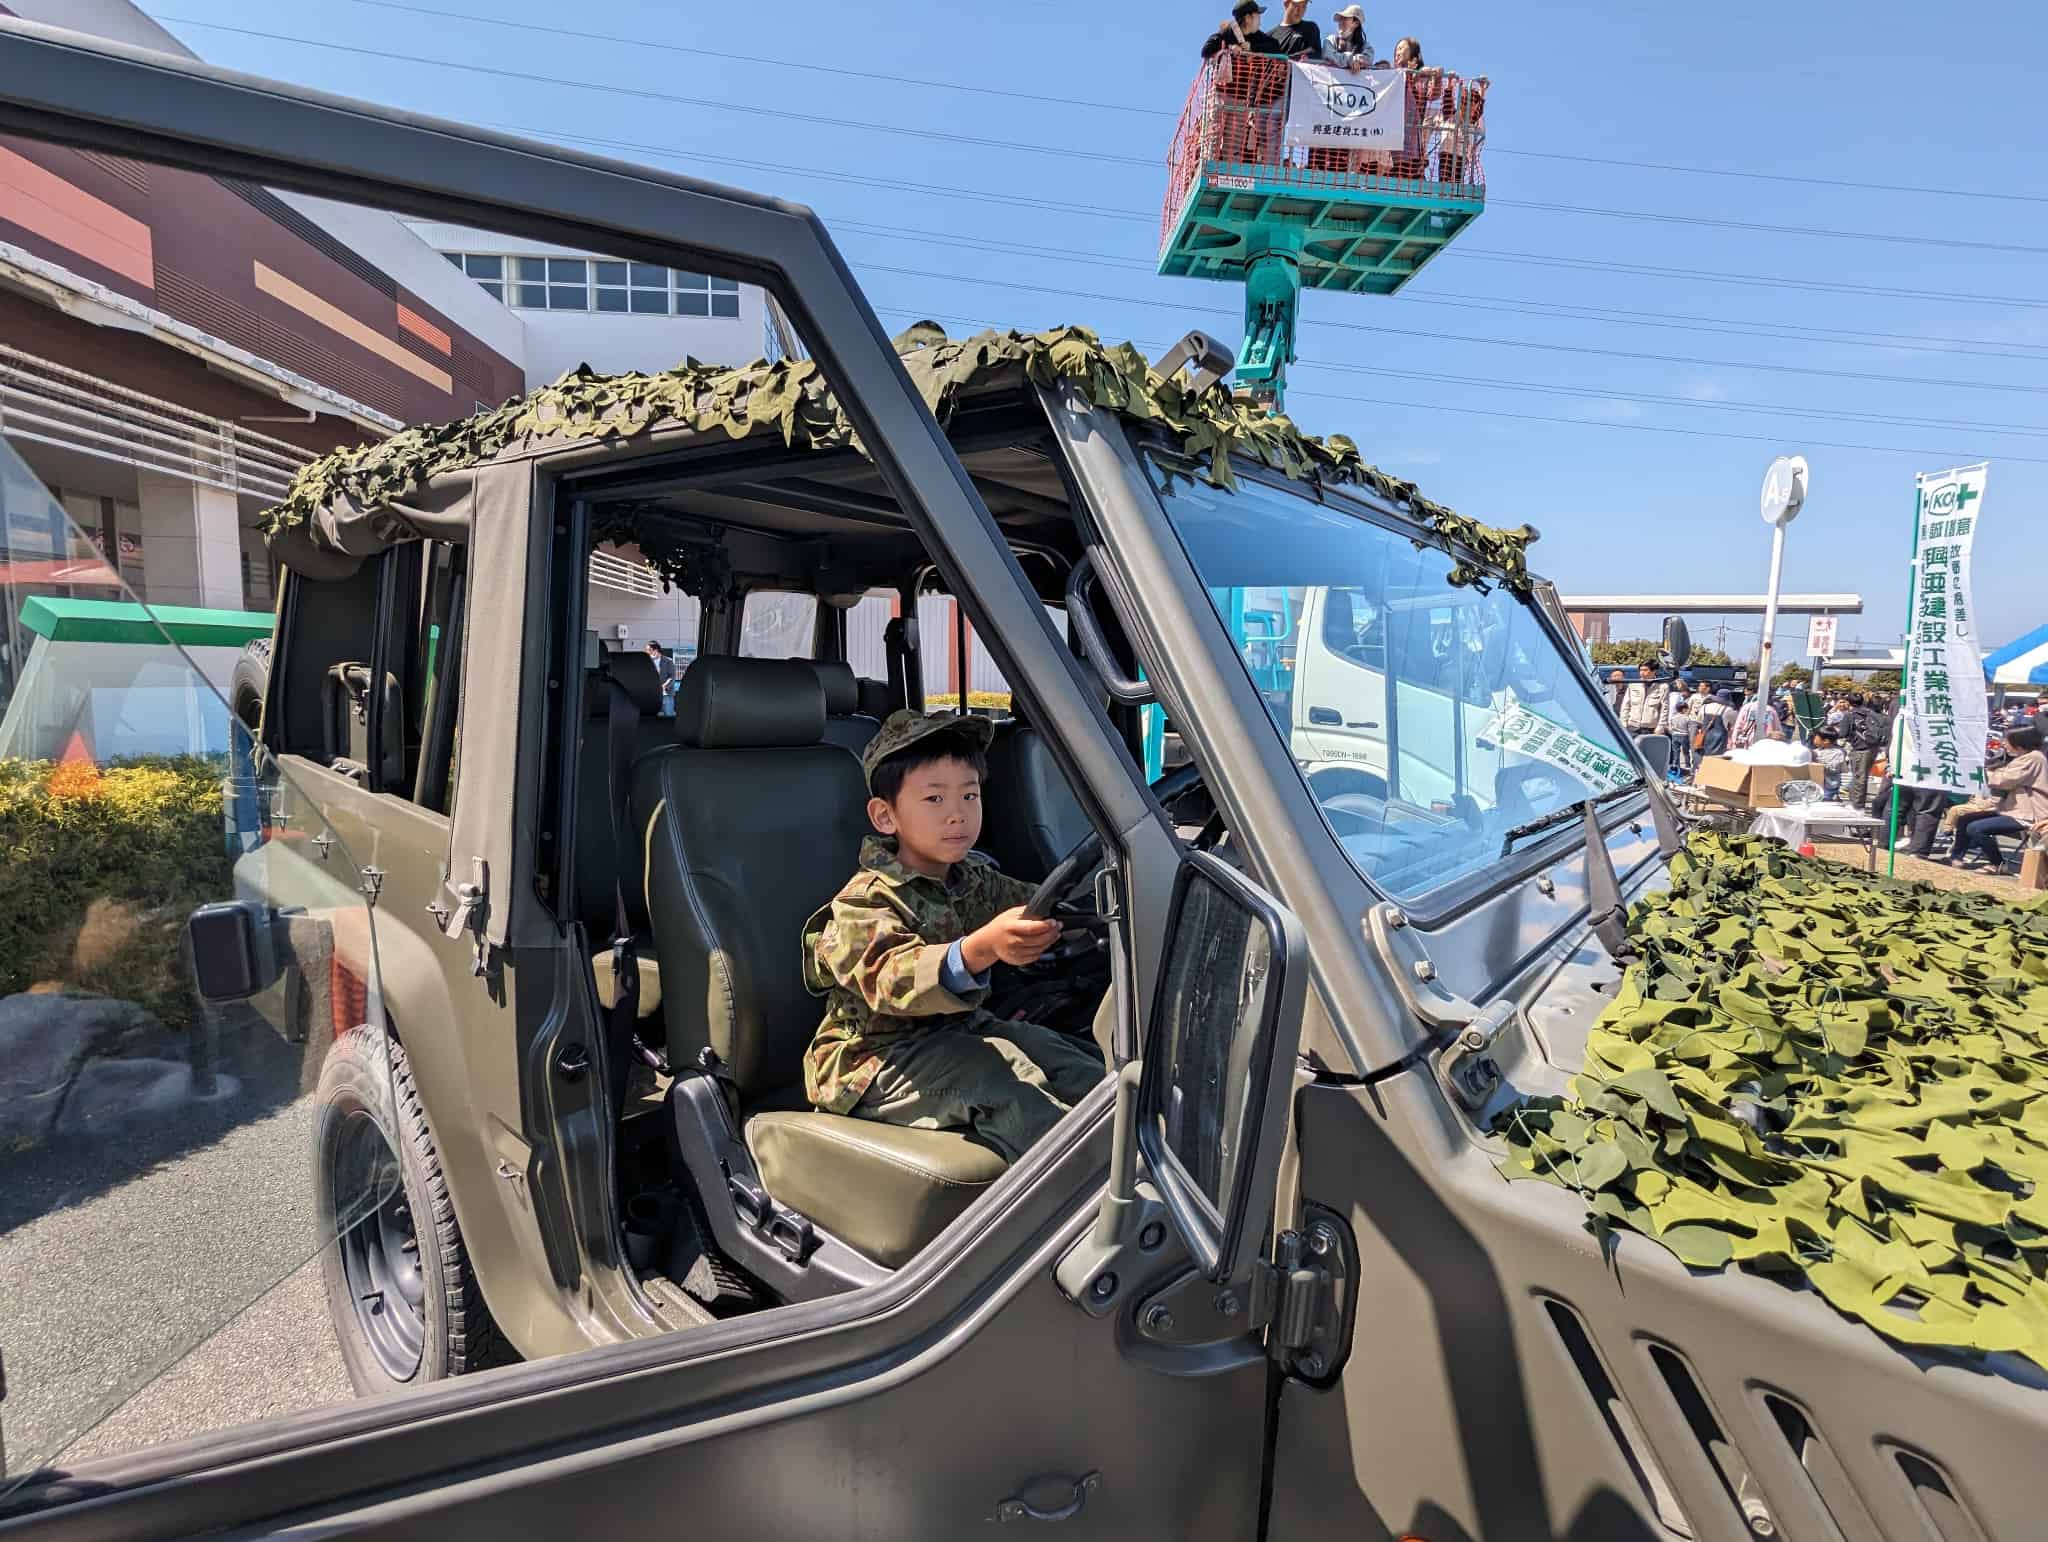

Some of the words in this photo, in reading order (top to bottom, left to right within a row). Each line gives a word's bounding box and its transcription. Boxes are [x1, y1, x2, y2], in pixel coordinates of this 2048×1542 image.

[1333, 90, 1369, 108] KOA
[1922, 546, 1965, 788] 興亜建設工業株式会社
